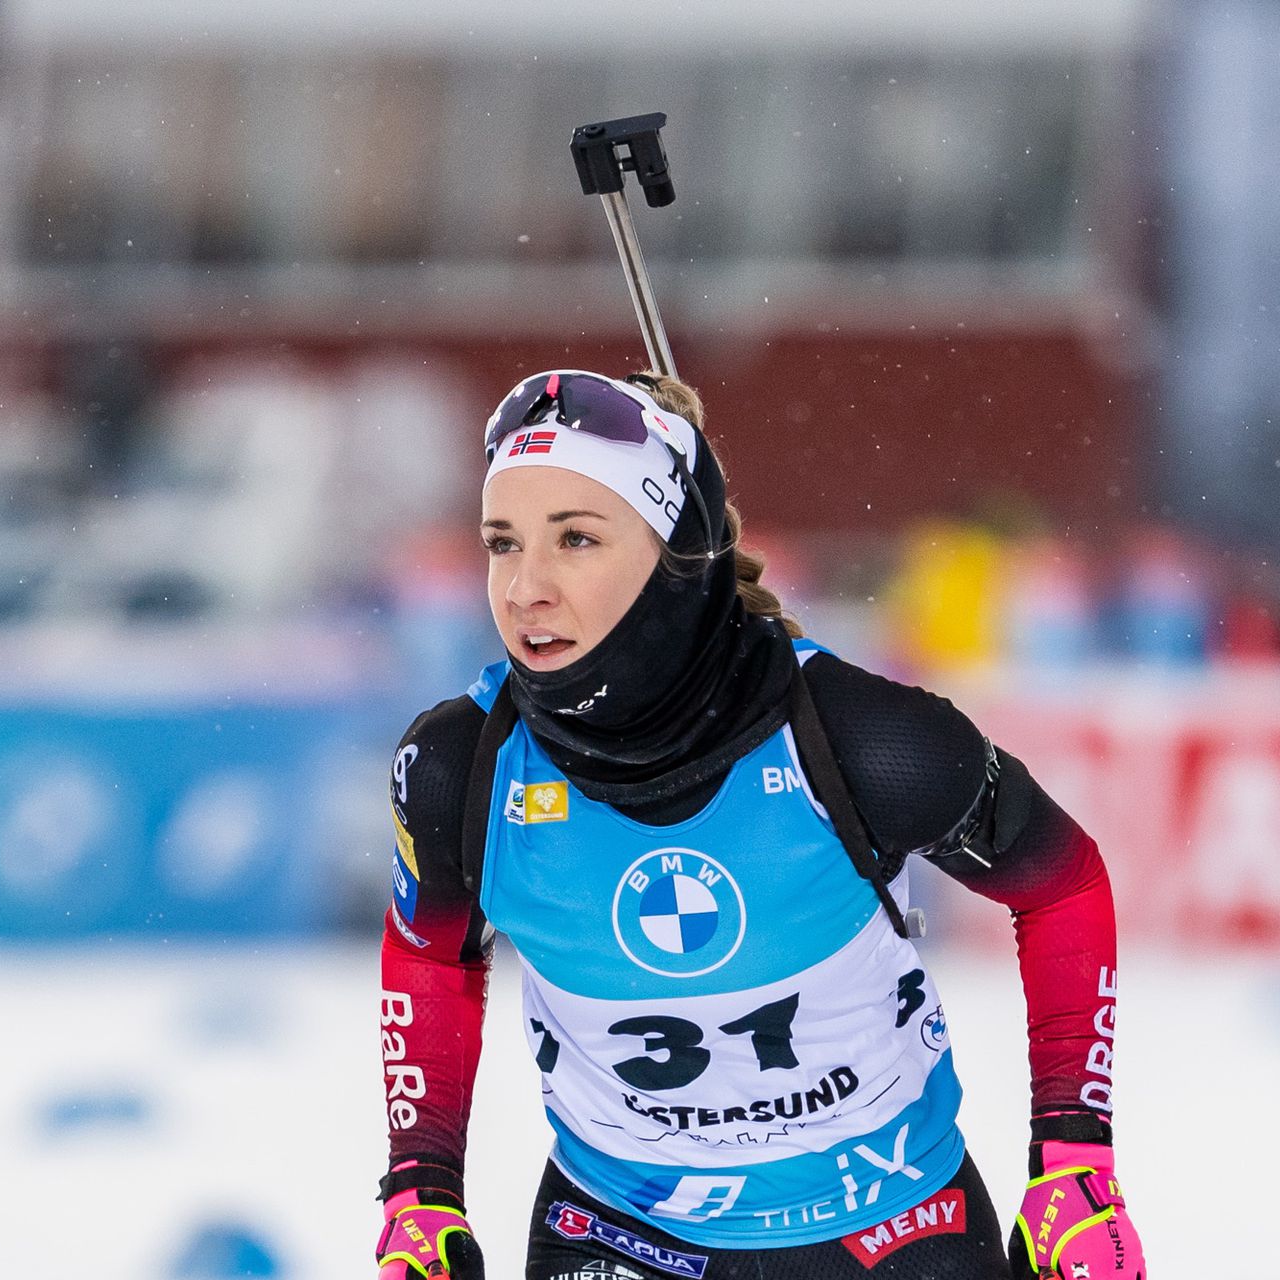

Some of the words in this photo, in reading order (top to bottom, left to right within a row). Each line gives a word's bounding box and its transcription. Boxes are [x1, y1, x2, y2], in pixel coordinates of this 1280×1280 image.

[628, 854, 722, 894] BMW
[608, 990, 801, 1091] 31
[860, 1200, 958, 1254] MENY
[1037, 1188, 1066, 1255] LEKI
[596, 1226, 695, 1272] LAPUA
